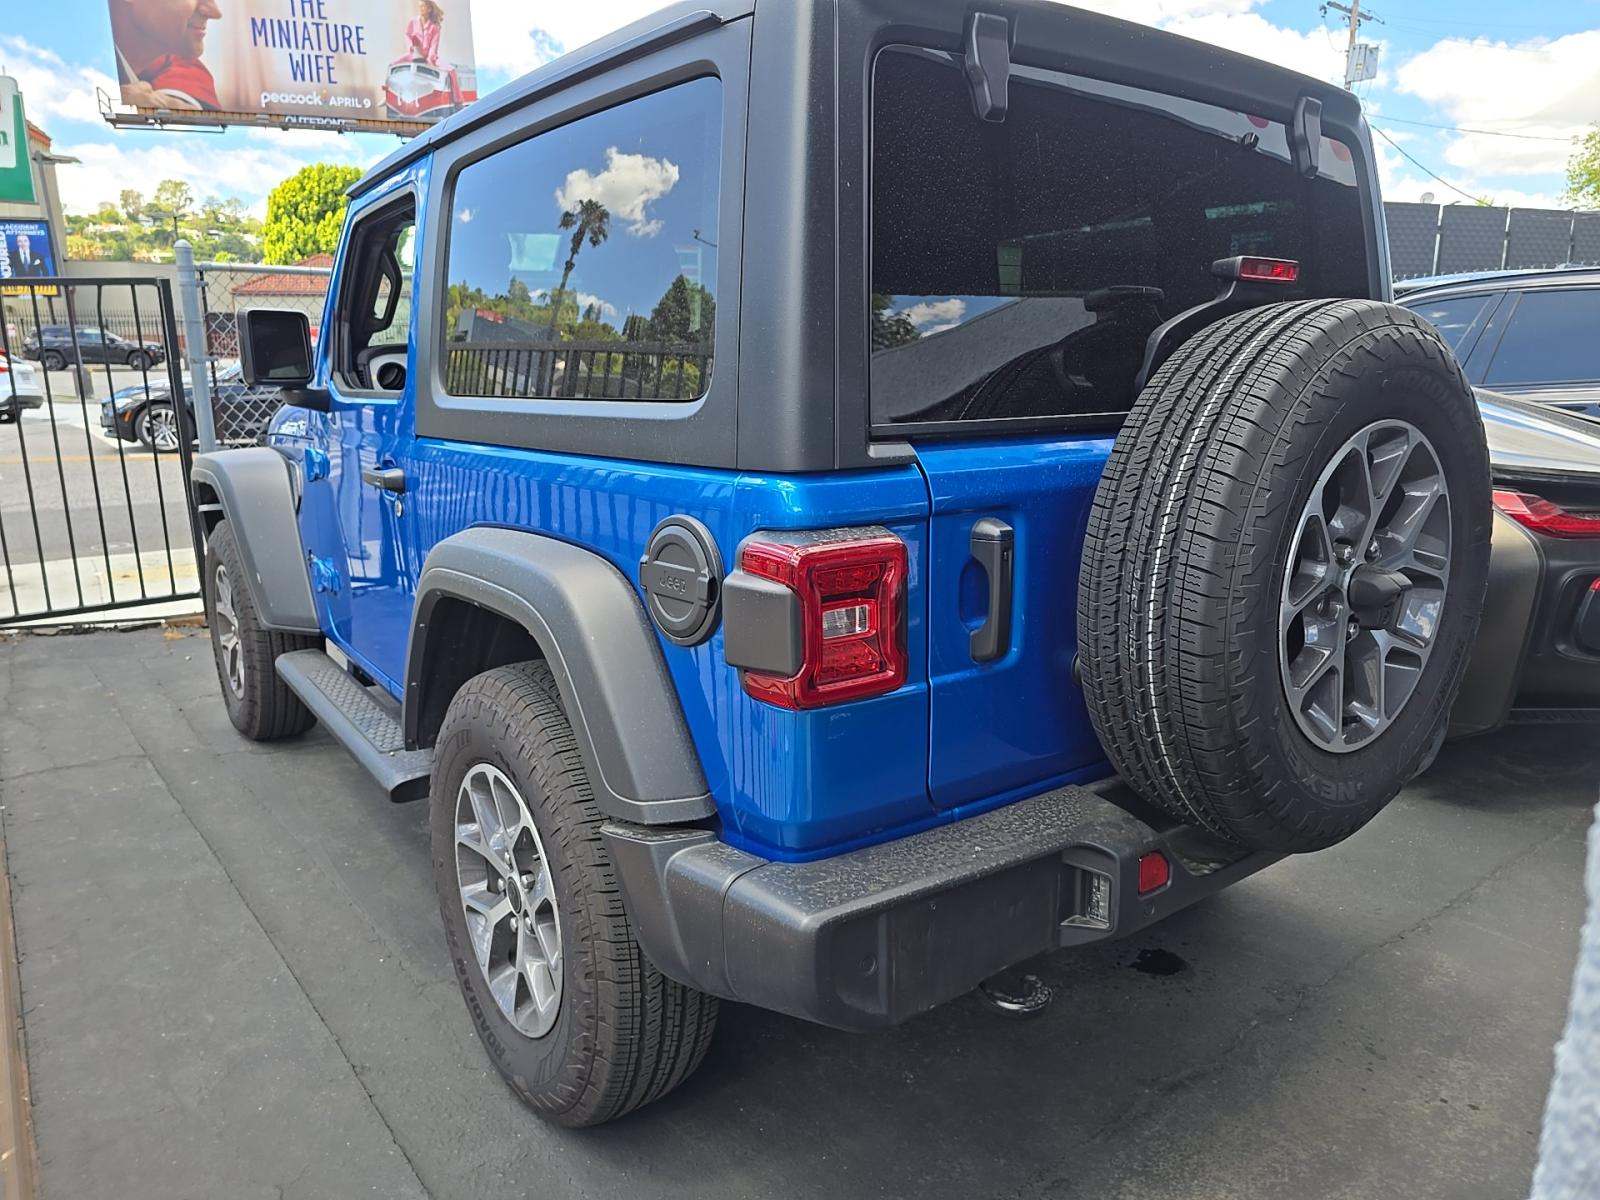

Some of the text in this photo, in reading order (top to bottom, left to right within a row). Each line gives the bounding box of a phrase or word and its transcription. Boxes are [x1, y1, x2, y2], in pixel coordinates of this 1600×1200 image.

[291, 0, 328, 20] THE
[251, 17, 367, 55] MINIATURE
[288, 52, 338, 85] WIFE
[260, 90, 322, 108] peacock
[329, 95, 372, 109] APRIL 9
[658, 574, 687, 595] Jeep
